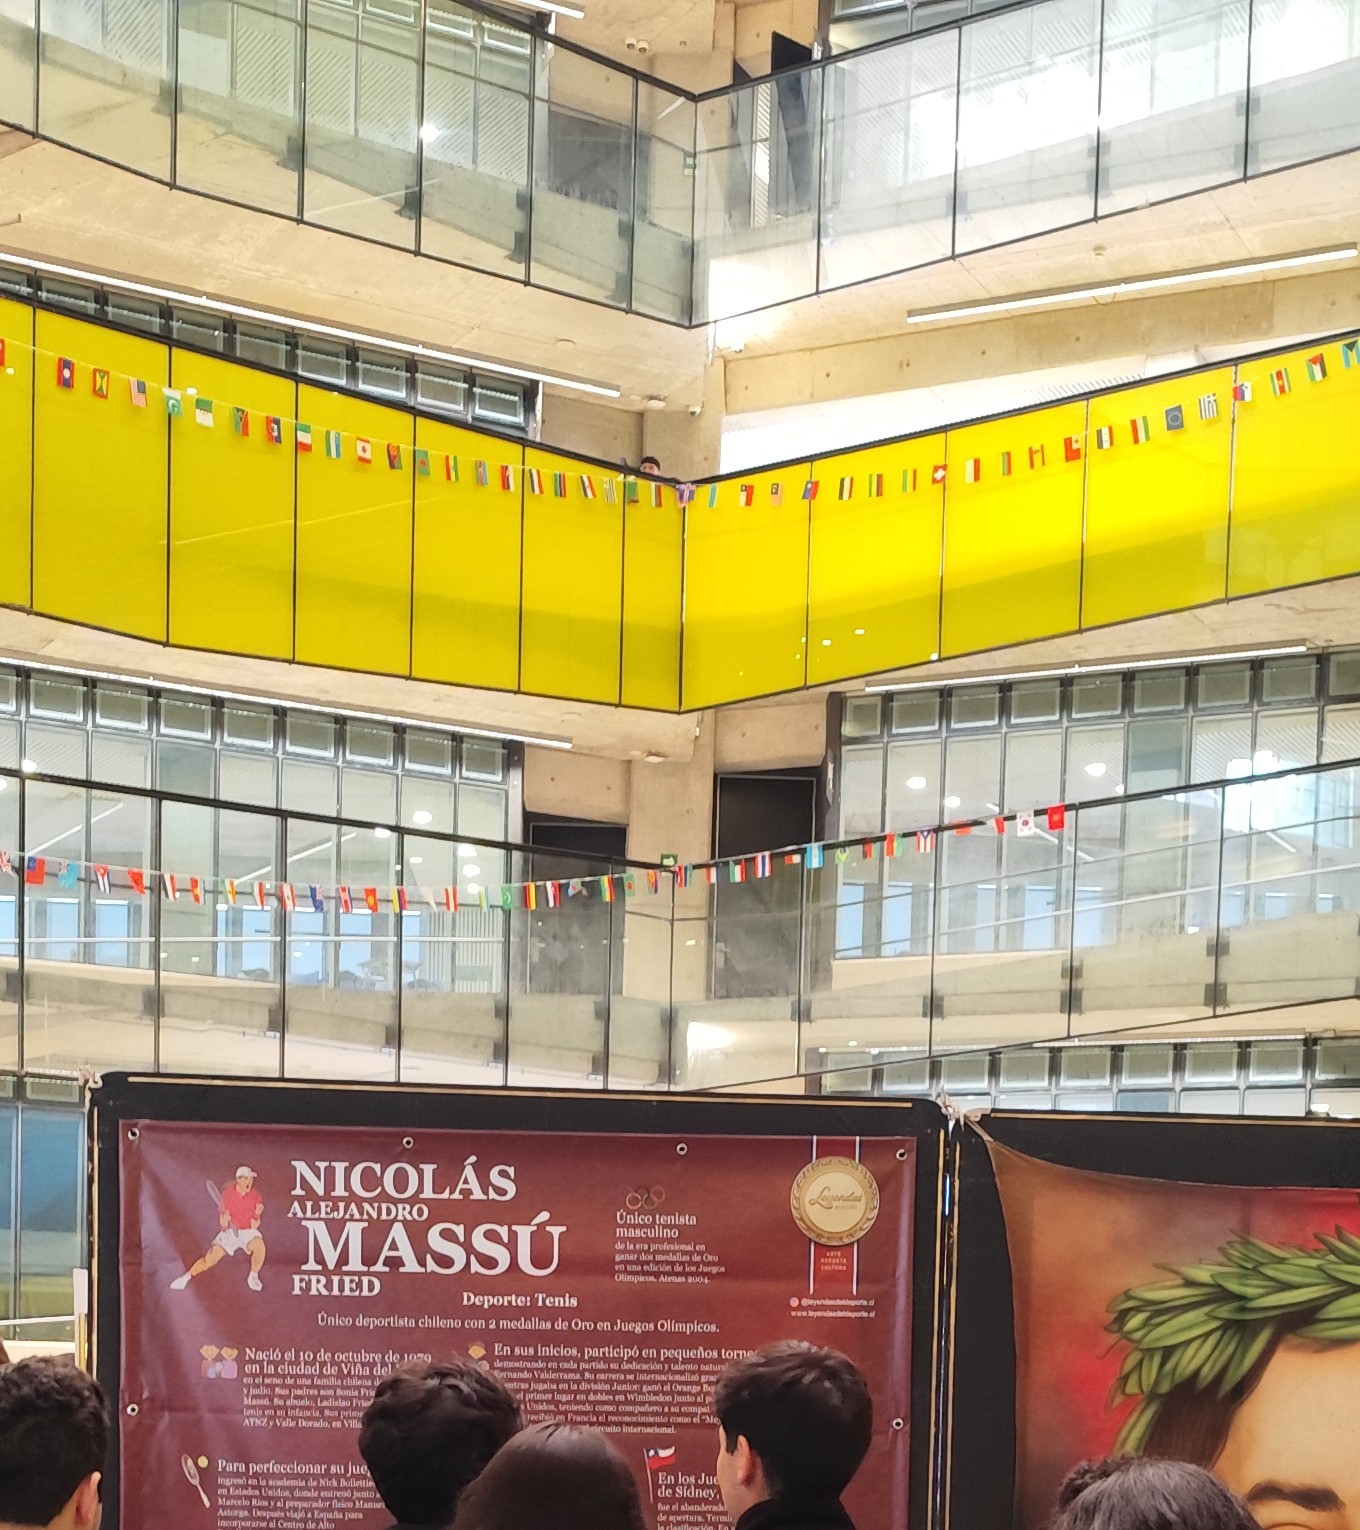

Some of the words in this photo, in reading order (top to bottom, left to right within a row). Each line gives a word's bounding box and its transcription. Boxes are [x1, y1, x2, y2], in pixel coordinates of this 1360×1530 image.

[290, 1155, 517, 1201] NICOLÁS
[287, 1200, 429, 1221] ALEJANDRO
[616, 1209, 653, 1225] Único
[656, 1212, 697, 1225] tenista
[616, 1225, 679, 1238] masculino
[300, 1210, 567, 1277] MASSÚ
[292, 1274, 381, 1297] FRIED
[462, 1292, 531, 1310] Deporte:
[534, 1294, 578, 1307] Tenis
[318, 1311, 352, 1326] Único
[355, 1314, 416, 1330] deportista
[419, 1315, 461, 1328] chileno
[464, 1319, 485, 1328] con
[488, 1319, 496, 1328] 2
[499, 1316, 551, 1329] medallas
[554, 1317, 569, 1329] de
[572, 1317, 594, 1330] Oro
[597, 1321, 610, 1330] en
[614, 1318, 654, 1334] Juegos
[657, 1319, 720, 1335] Olímpicos.
[246, 1348, 281, 1361] Nació
[284, 1349, 294, 1361] el
[316, 1349, 332, 1362] de
[335, 1349, 382, 1362] octubre
[385, 1350, 400, 1362] de
[495, 1343, 511, 1355] En
[514, 1347, 534, 1356] sus
[538, 1344, 583, 1359] inicios,
[586, 1344, 639, 1360] participó
[642, 1349, 659, 1358] en
[662, 1346, 718, 1361] pequeños
[722, 1346, 755, 1359] torne
[245, 1365, 259, 1374] en
[262, 1362, 274, 1374] la
[277, 1362, 319, 1375] ciudad
[322, 1363, 338, 1375] de
[341, 1363, 369, 1375] Viña
[373, 1363, 393, 1375] del
[218, 1460, 246, 1473] Para
[250, 1460, 327, 1477] perfeccionar
[330, 1466, 344, 1475] su
[658, 1472, 674, 1484] En
[678, 1472, 695, 1484] los
[698, 1472, 720, 1484] Jue
[658, 1486, 673, 1498] de
[676, 1486, 720, 1501] Sídney,
